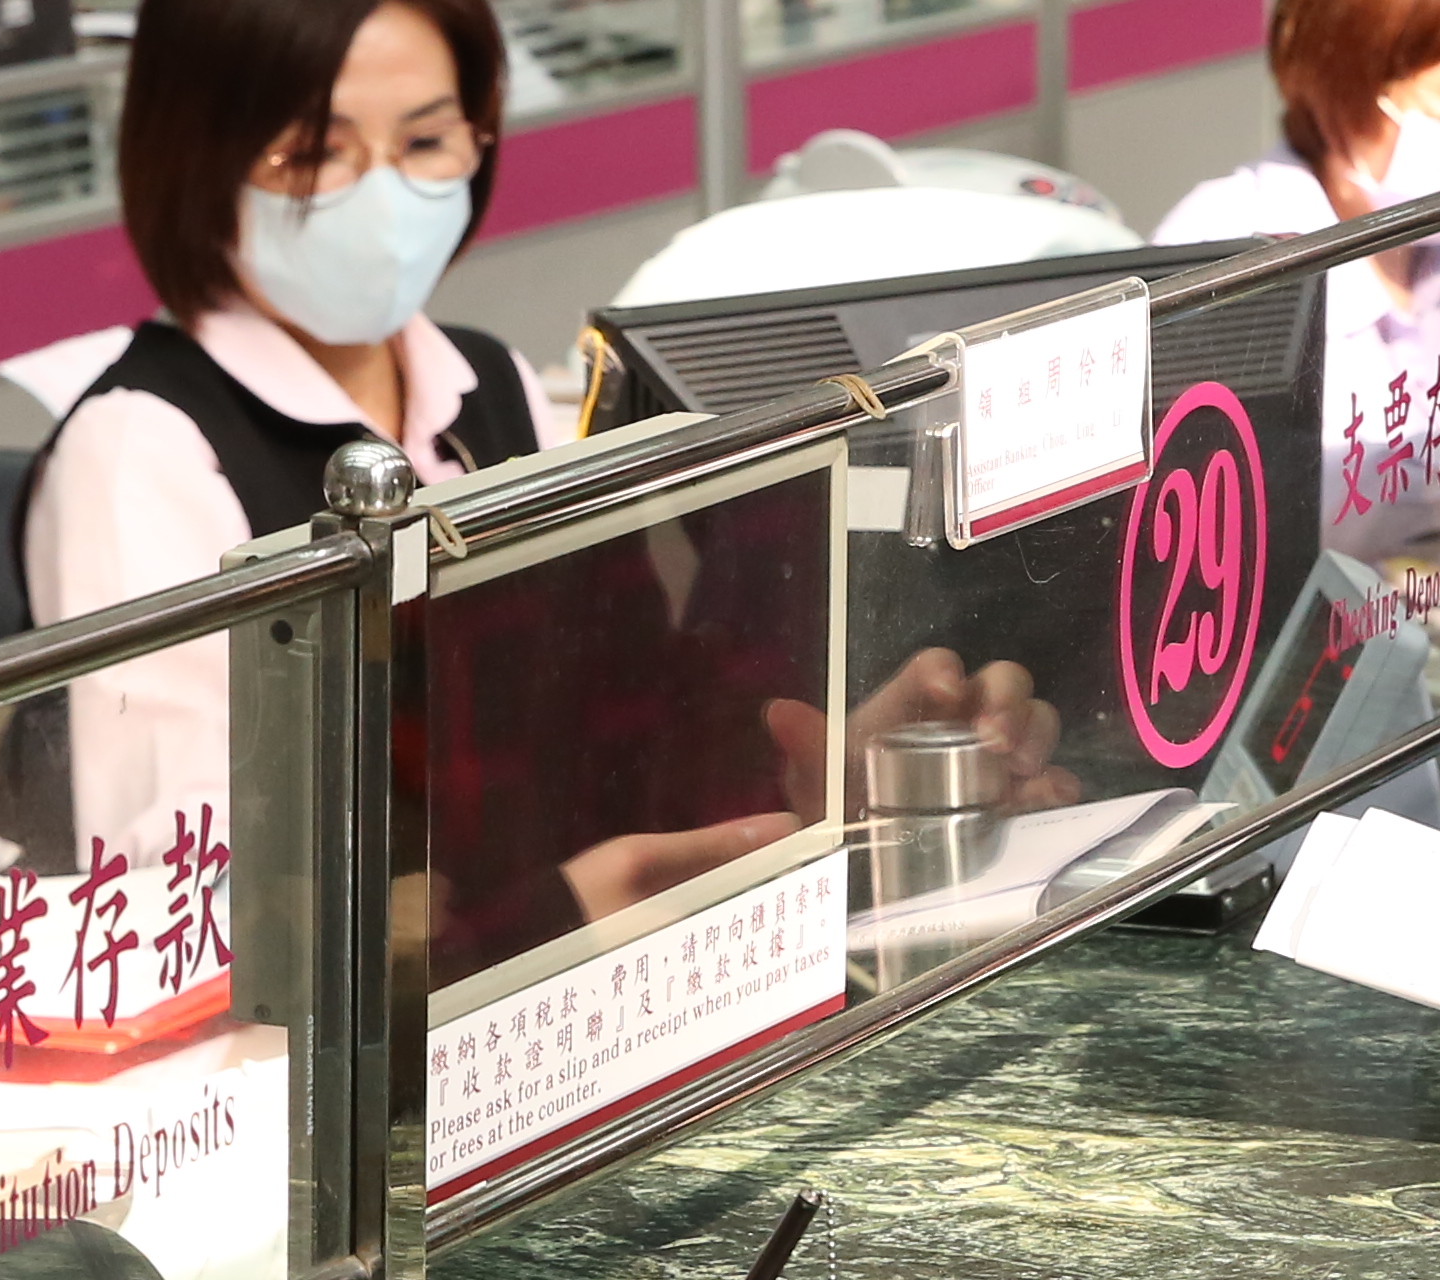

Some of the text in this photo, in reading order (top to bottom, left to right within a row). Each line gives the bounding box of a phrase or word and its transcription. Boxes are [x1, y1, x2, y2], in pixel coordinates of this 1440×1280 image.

[966, 477, 996, 498] Officer
[1005, 443, 1038, 465] Banking
[1150, 448, 1242, 706] 29
[1328, 581, 1400, 651] Checking
[429, 945, 830, 1145] Please ask for a slip and a receipt when you pay taxes
[113, 1083, 237, 1200] Deposits
[429, 1079, 602, 1173] or fees at the counter.
